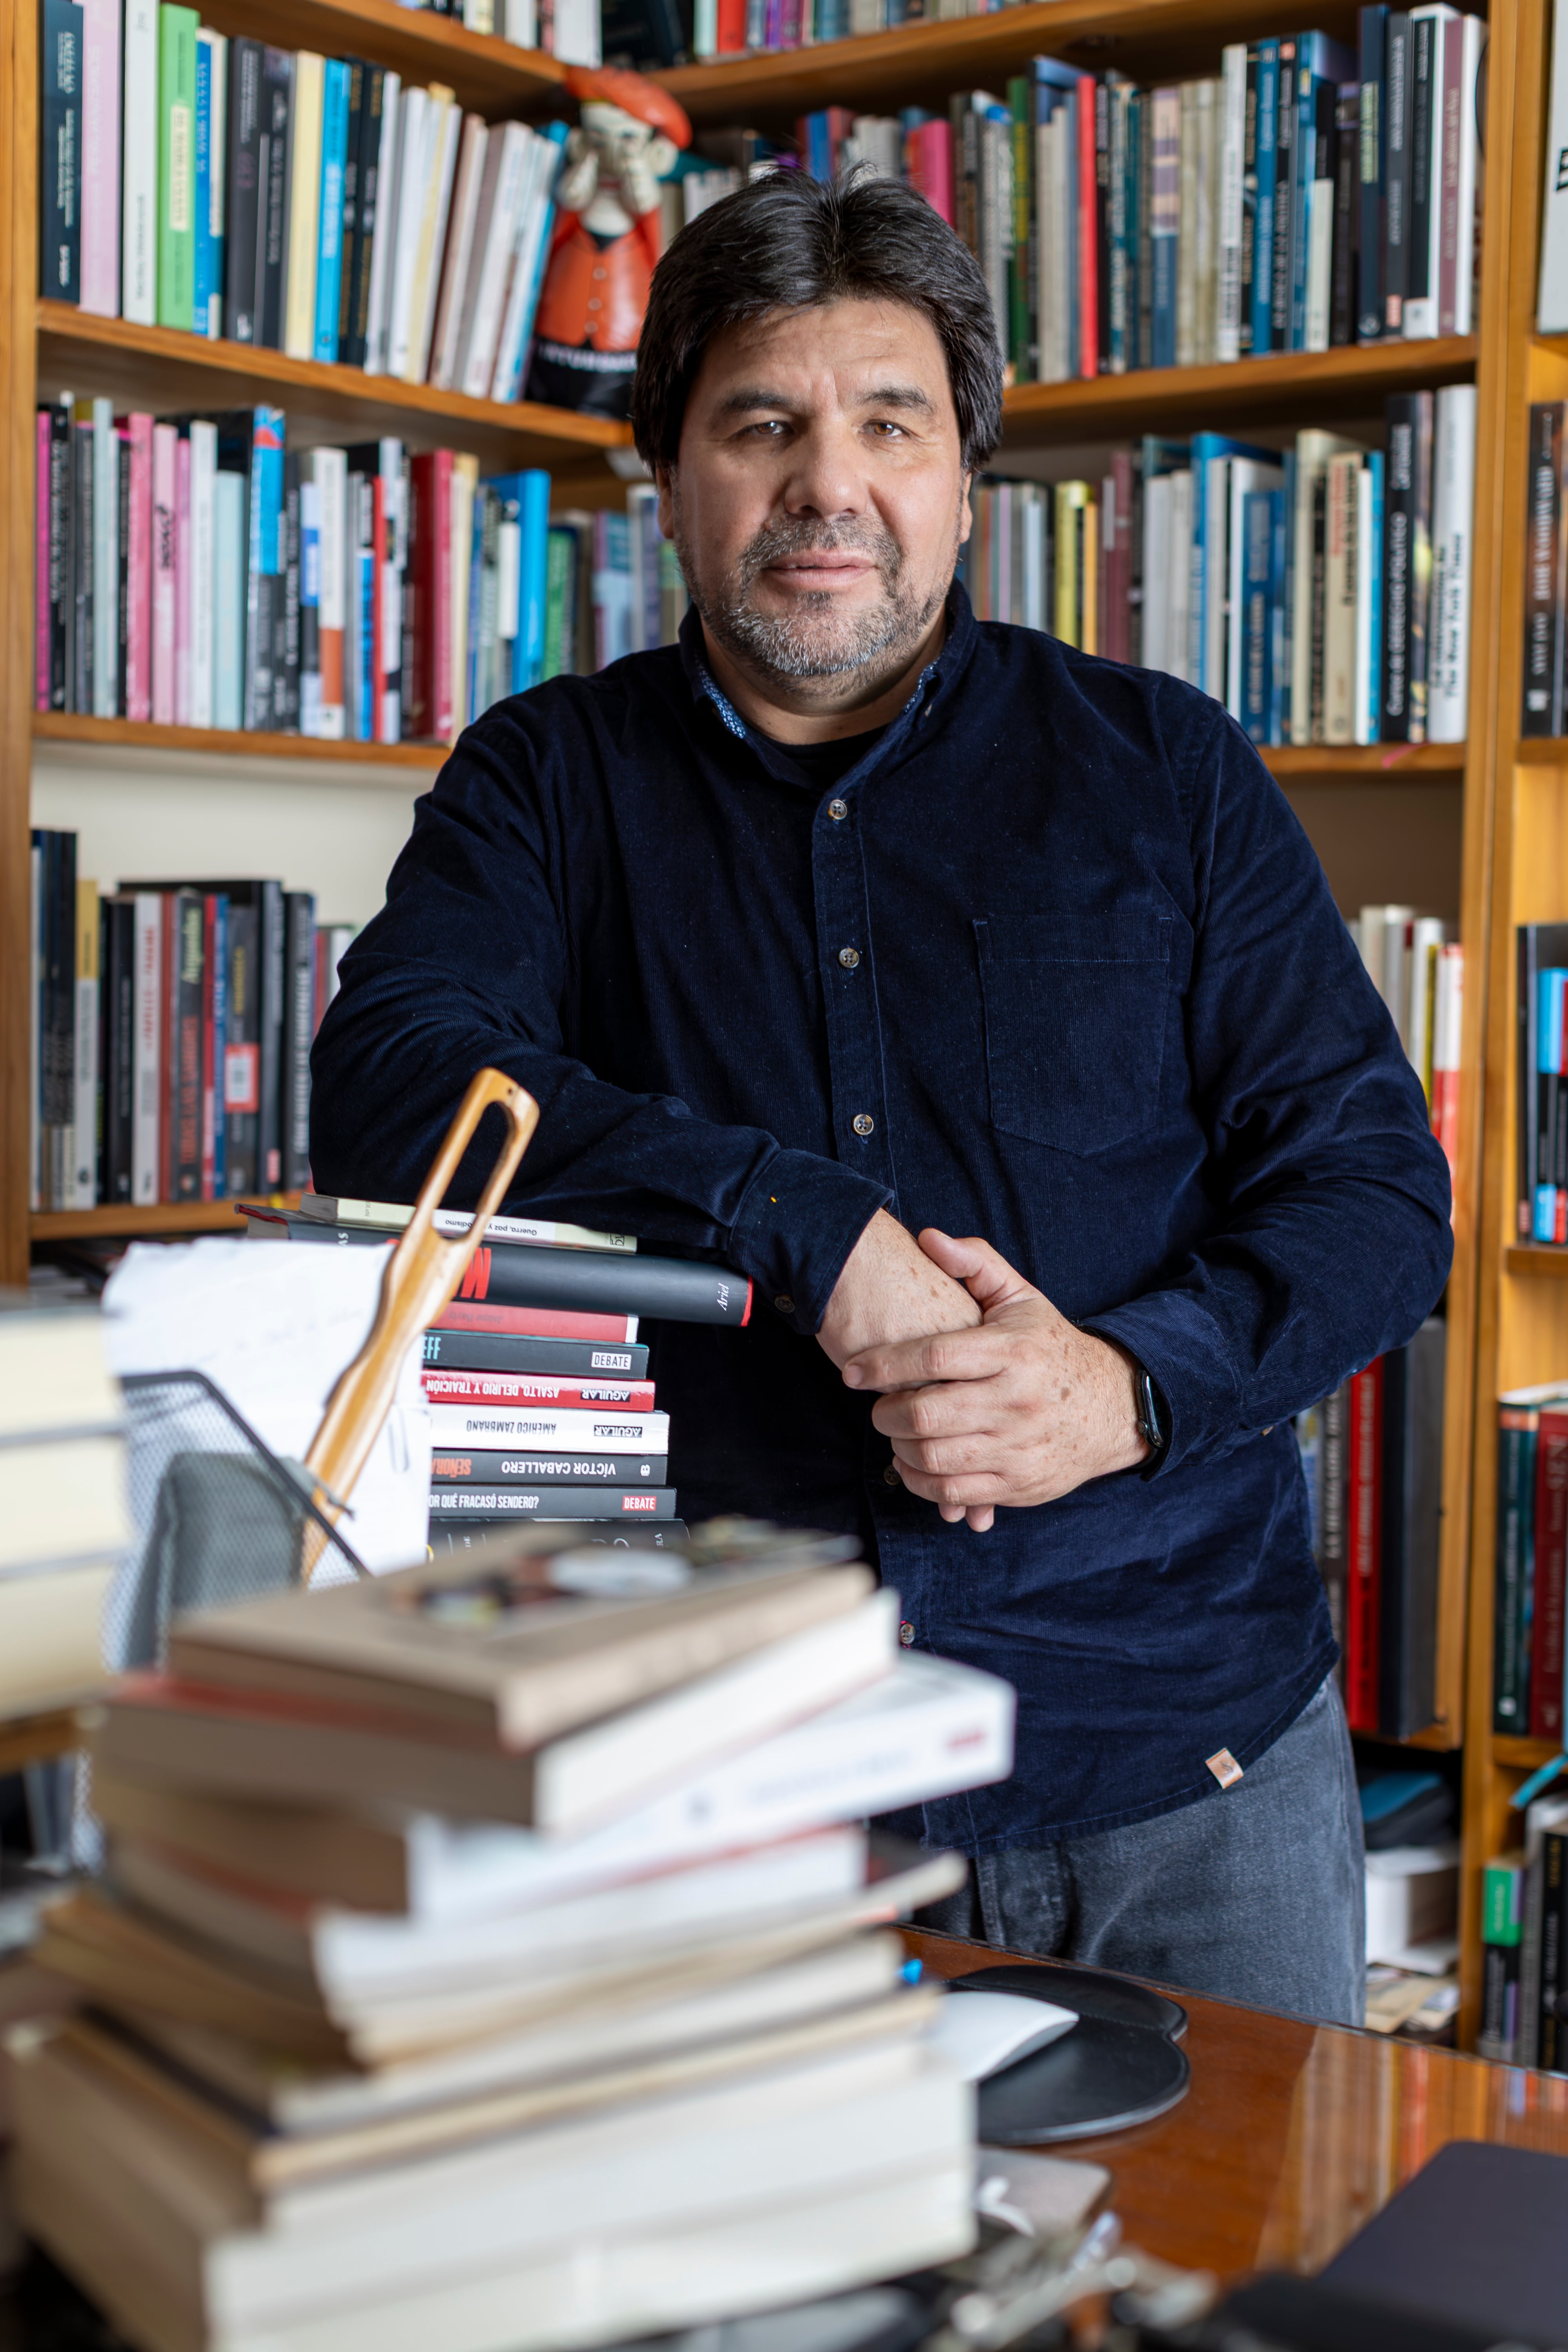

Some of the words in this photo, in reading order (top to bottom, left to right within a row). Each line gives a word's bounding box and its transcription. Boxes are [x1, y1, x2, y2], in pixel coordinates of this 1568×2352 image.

[510, 1225, 537, 1236] Guerra,
[717, 1282, 729, 1311] Ariel
[594, 1354, 629, 1368] DEBATE
[426, 1379, 472, 1395] TRAICIÓN
[473, 1382, 481, 1394] Y
[482, 1383, 519, 1397] DELIRIO
[521, 1383, 560, 1398] ASALTO,
[582, 1388, 630, 1401] AGUILAR
[466, 1420, 514, 1434] ZAMBRANO
[595, 1426, 641, 1437] AGUILAR
[501, 1461, 571, 1474] CABALLERO
[573, 1462, 617, 1478] VÍCTOR
[428, 1494, 440, 1508] OR
[441, 1493, 458, 1508] QUÉ
[458, 1493, 497, 1508] FRACASÓ
[497, 1495, 540, 1509] SENDERO?
[624, 1497, 655, 1510] DEBATE
